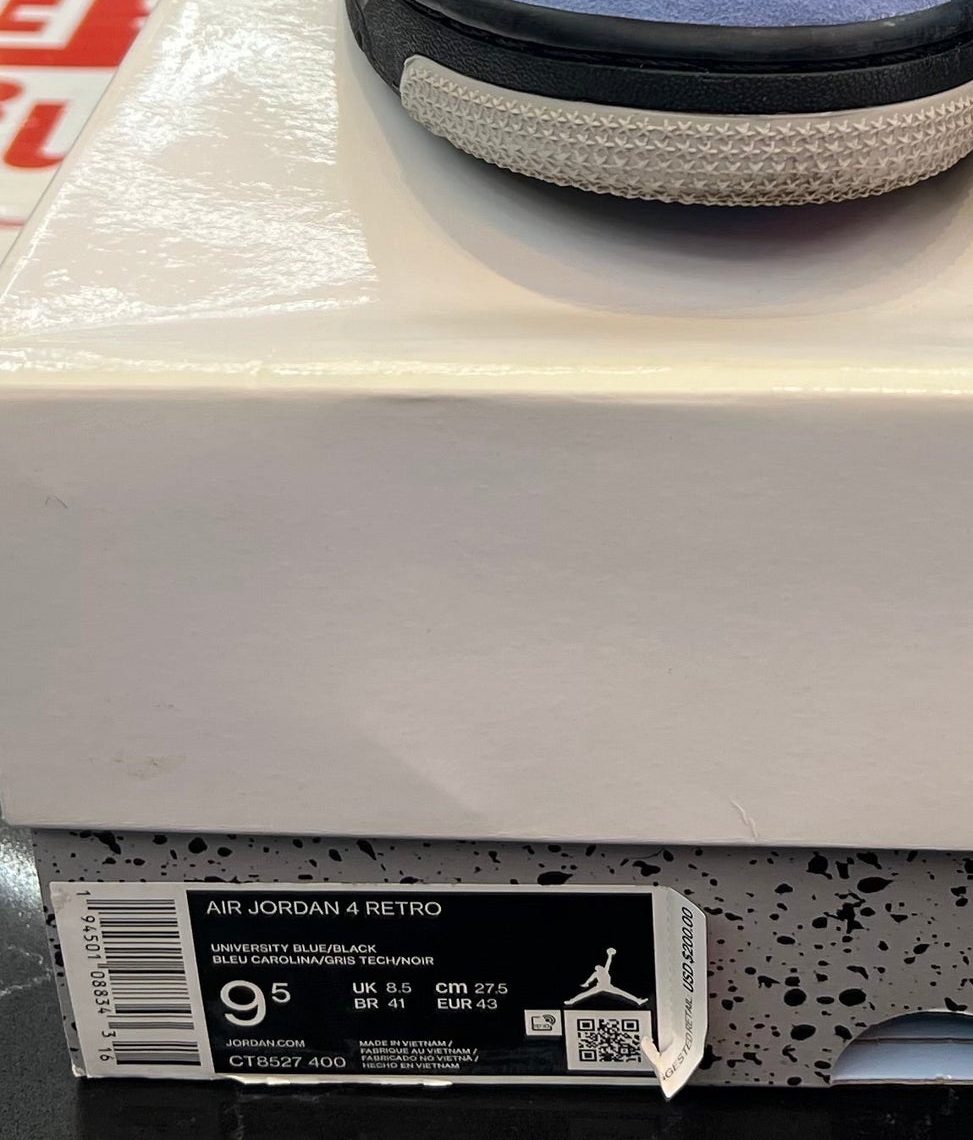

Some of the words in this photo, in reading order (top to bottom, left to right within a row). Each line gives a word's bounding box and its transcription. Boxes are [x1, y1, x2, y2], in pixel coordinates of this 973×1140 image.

[206, 900, 242, 916] AIR
[248, 900, 340, 916] JORDAN
[346, 901, 360, 915] 4
[366, 901, 442, 916] RETRO
[81, 916, 102, 960] 94501
[681, 906, 695, 964] $200.00
[210, 943, 289, 953] UNIVERSITY
[293, 943, 377, 954] BLUE/BLACK
[212, 955, 248, 965] BLEU
[250, 955, 356, 966] CAROLINA/GRIS
[358, 956, 435, 967] TECH/NOIR
[682, 961, 695, 993] USD
[90, 971, 111, 1015] 08834
[352, 982, 378, 994] UK
[386, 982, 412, 994] 8.5
[435, 982, 468, 994] cm
[474, 982, 508, 994] 27.5
[354, 998, 379, 1009] BR
[387, 998, 405, 1009] 41
[437, 998, 473, 1010] EUR
[476, 998, 498, 1010] 43
[226, 1039, 306, 1048] JORDAN.COM
[98, 1047, 114, 1062] 16
[360, 1047, 409, 1055] FABRIQUE
[411, 1047, 425, 1055] AU
[661, 1032, 693, 1081] GESTED
[229, 1055, 303, 1068] CT8527
[308, 1056, 347, 1068] 400
